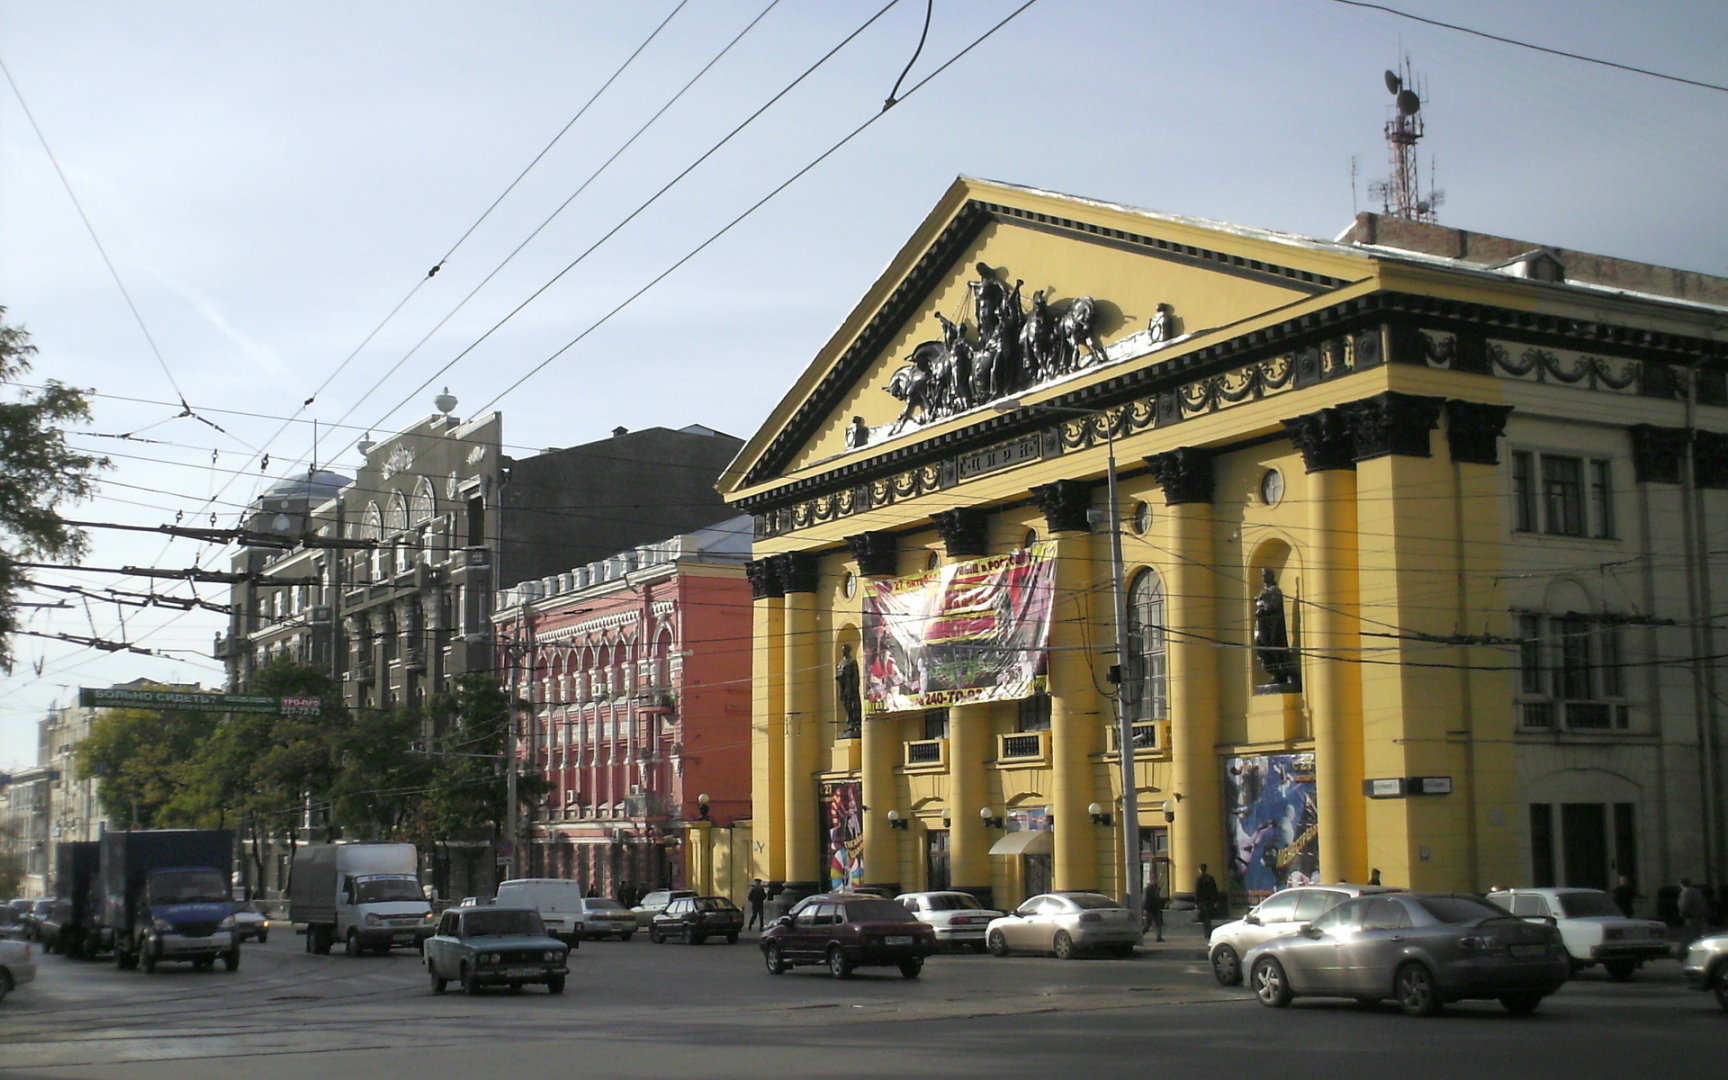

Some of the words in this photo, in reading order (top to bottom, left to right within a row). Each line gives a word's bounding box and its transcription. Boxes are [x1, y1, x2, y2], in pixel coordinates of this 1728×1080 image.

[894, 580, 903, 590] 27
[95, 690, 152, 701] БОЛЬНО
[156, 692, 217, 704] СИДЕТЬ?
[281, 706, 320, 716] 227-72-72
